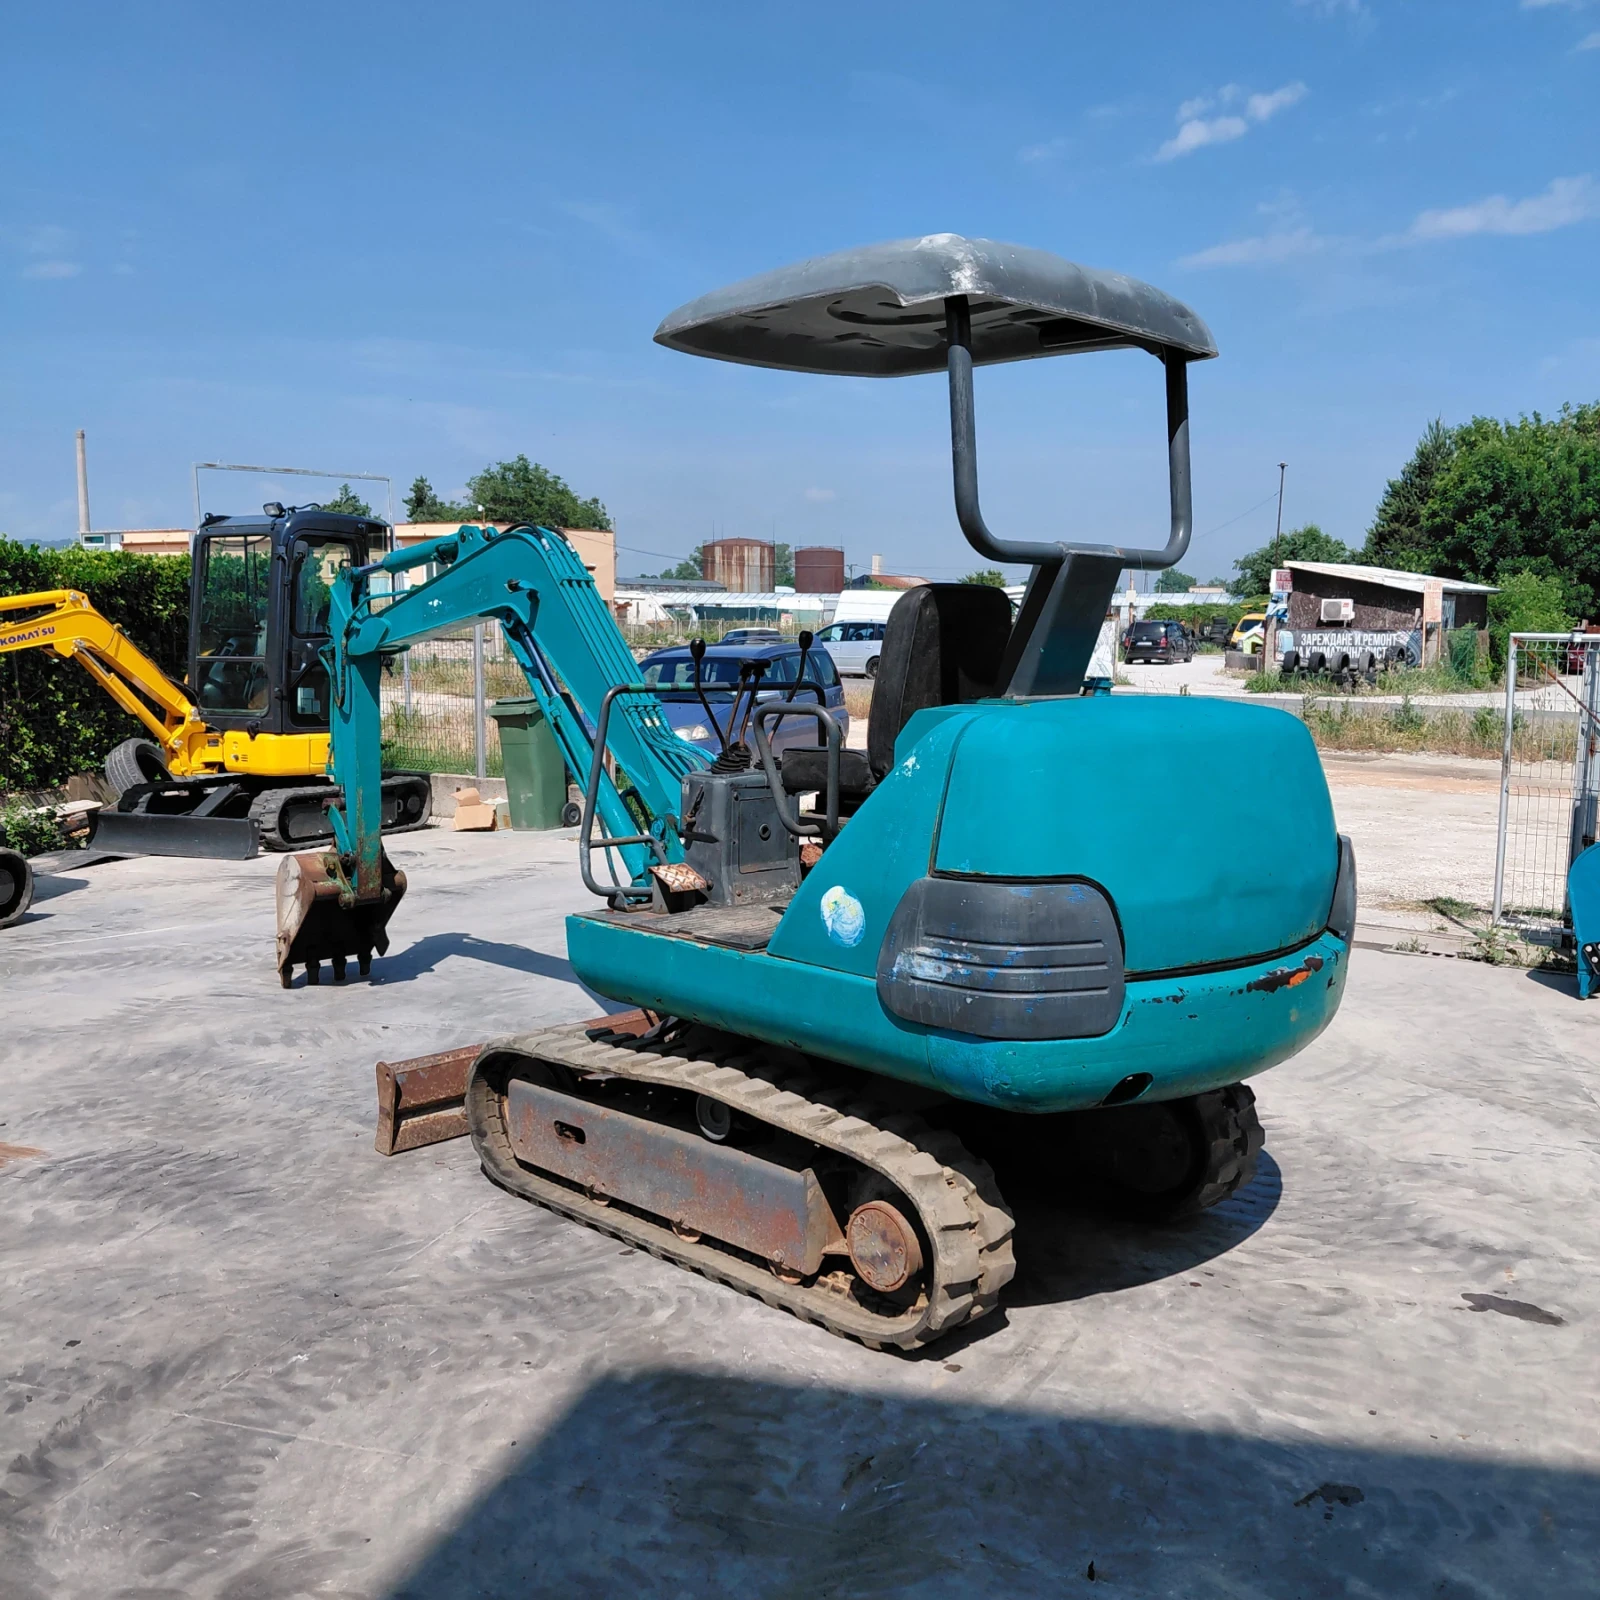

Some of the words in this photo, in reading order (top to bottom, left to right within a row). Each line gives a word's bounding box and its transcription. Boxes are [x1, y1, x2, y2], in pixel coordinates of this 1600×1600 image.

[0, 626, 55, 646] KOMATSU
[1301, 633, 1352, 646] ЗАРЕЖДАНЕ
[1354, 633, 1361, 646] И
[1363, 633, 1397, 646] РЕМОНТ
